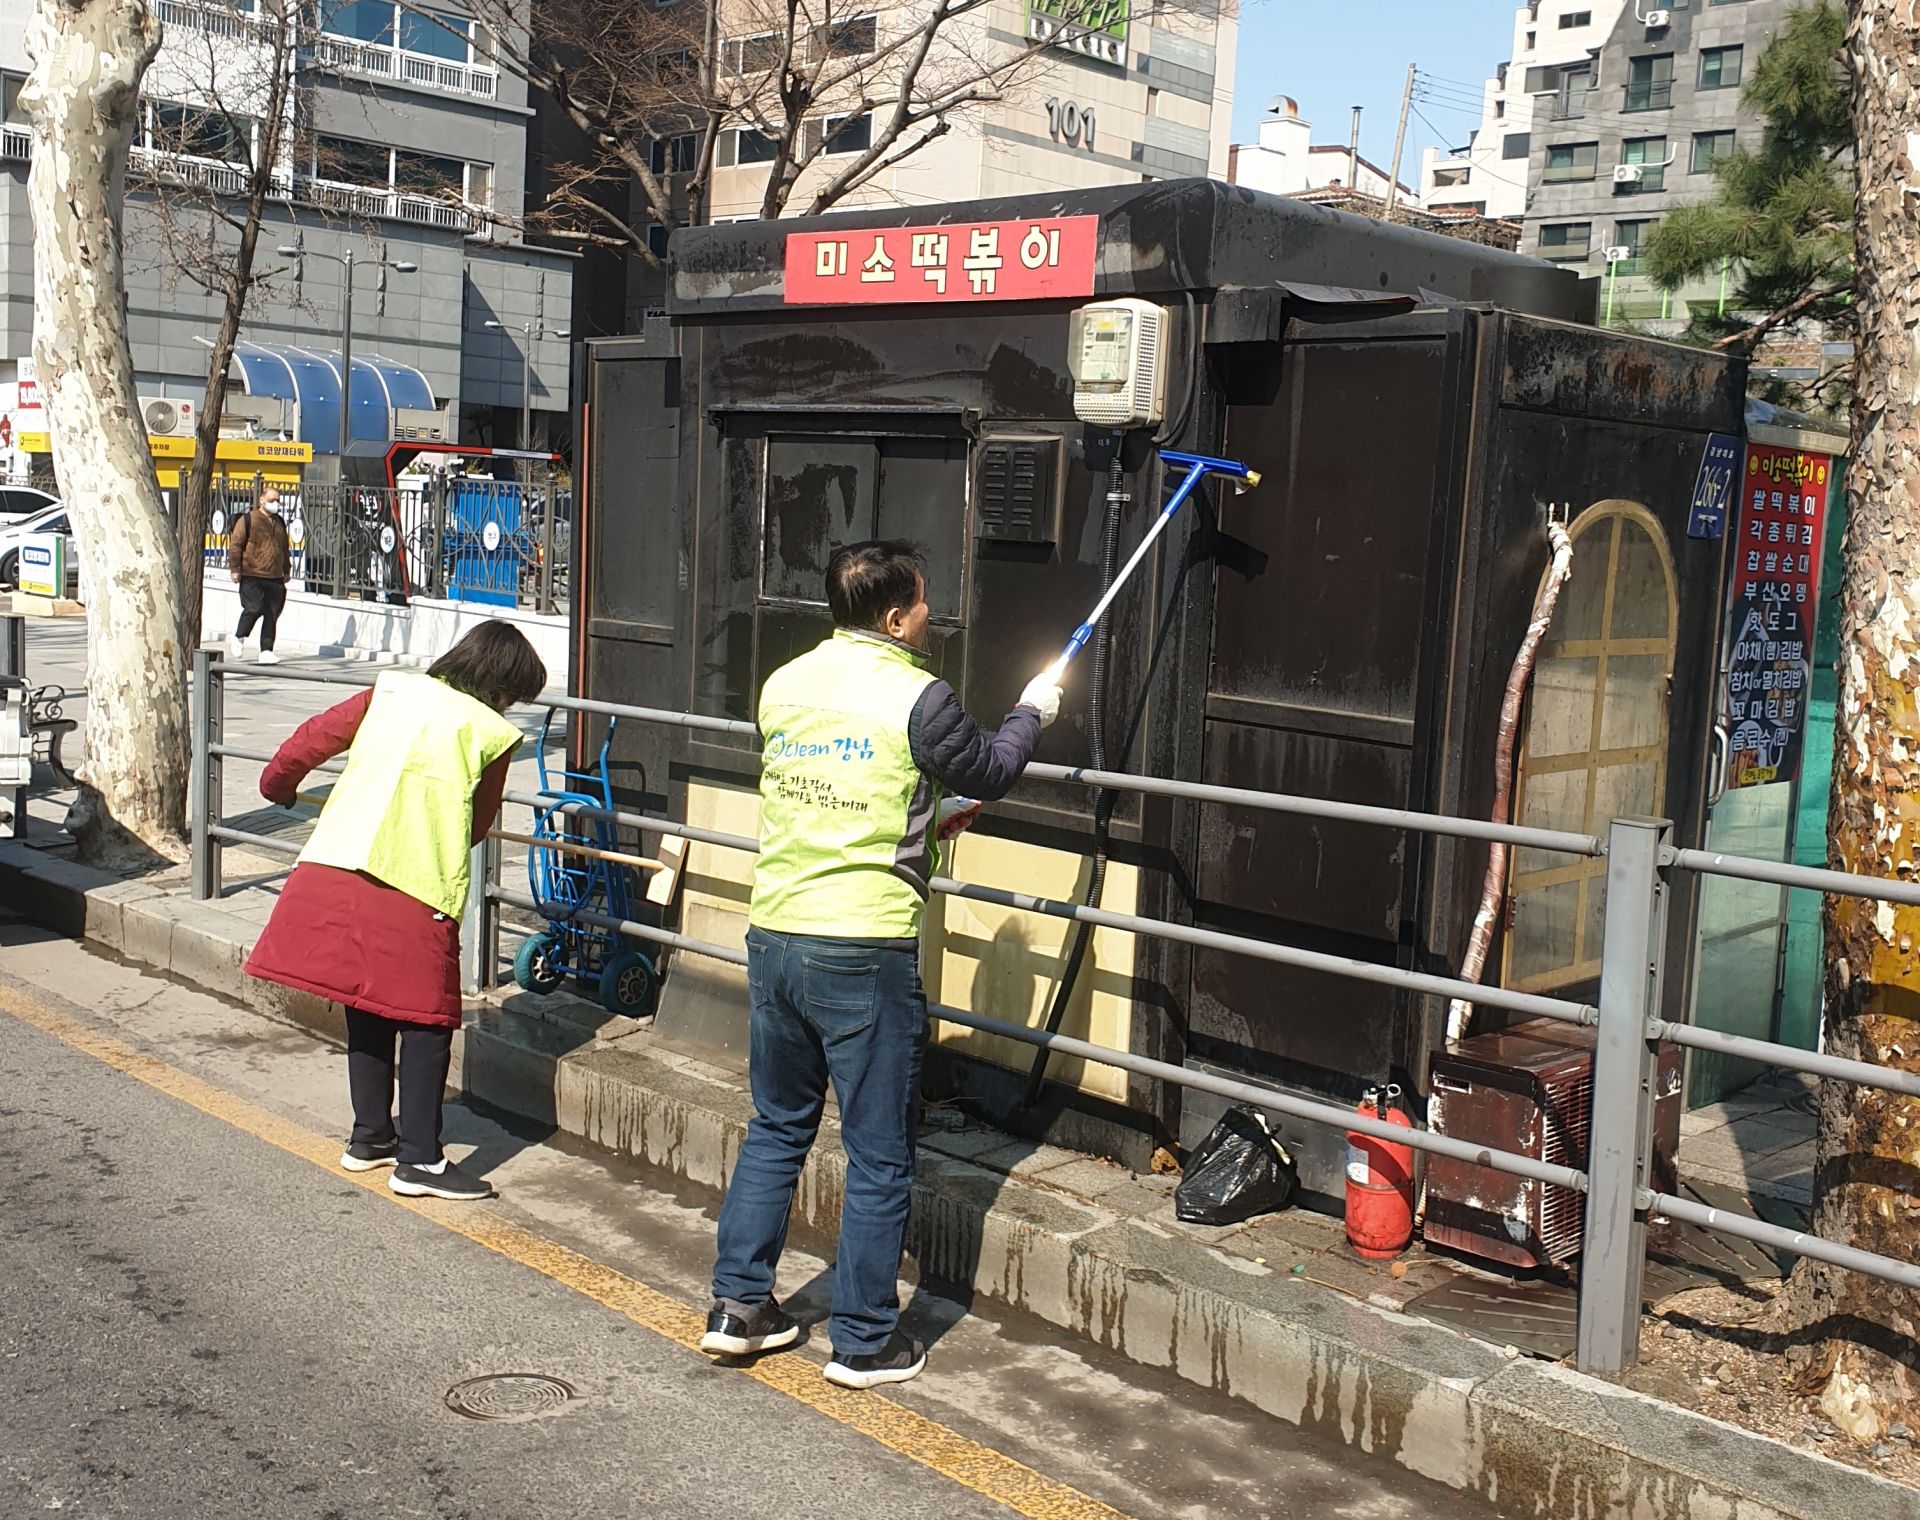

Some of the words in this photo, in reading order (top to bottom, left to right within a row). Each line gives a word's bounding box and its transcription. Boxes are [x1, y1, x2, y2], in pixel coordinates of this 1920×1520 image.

[1045, 96, 1096, 143] 101
[815, 224, 1061, 295] 미소떡볶이
[1695, 465, 1731, 509] 266-2
[1762, 453, 1814, 486] 미소떡볶이
[832, 737, 875, 762] 강남
